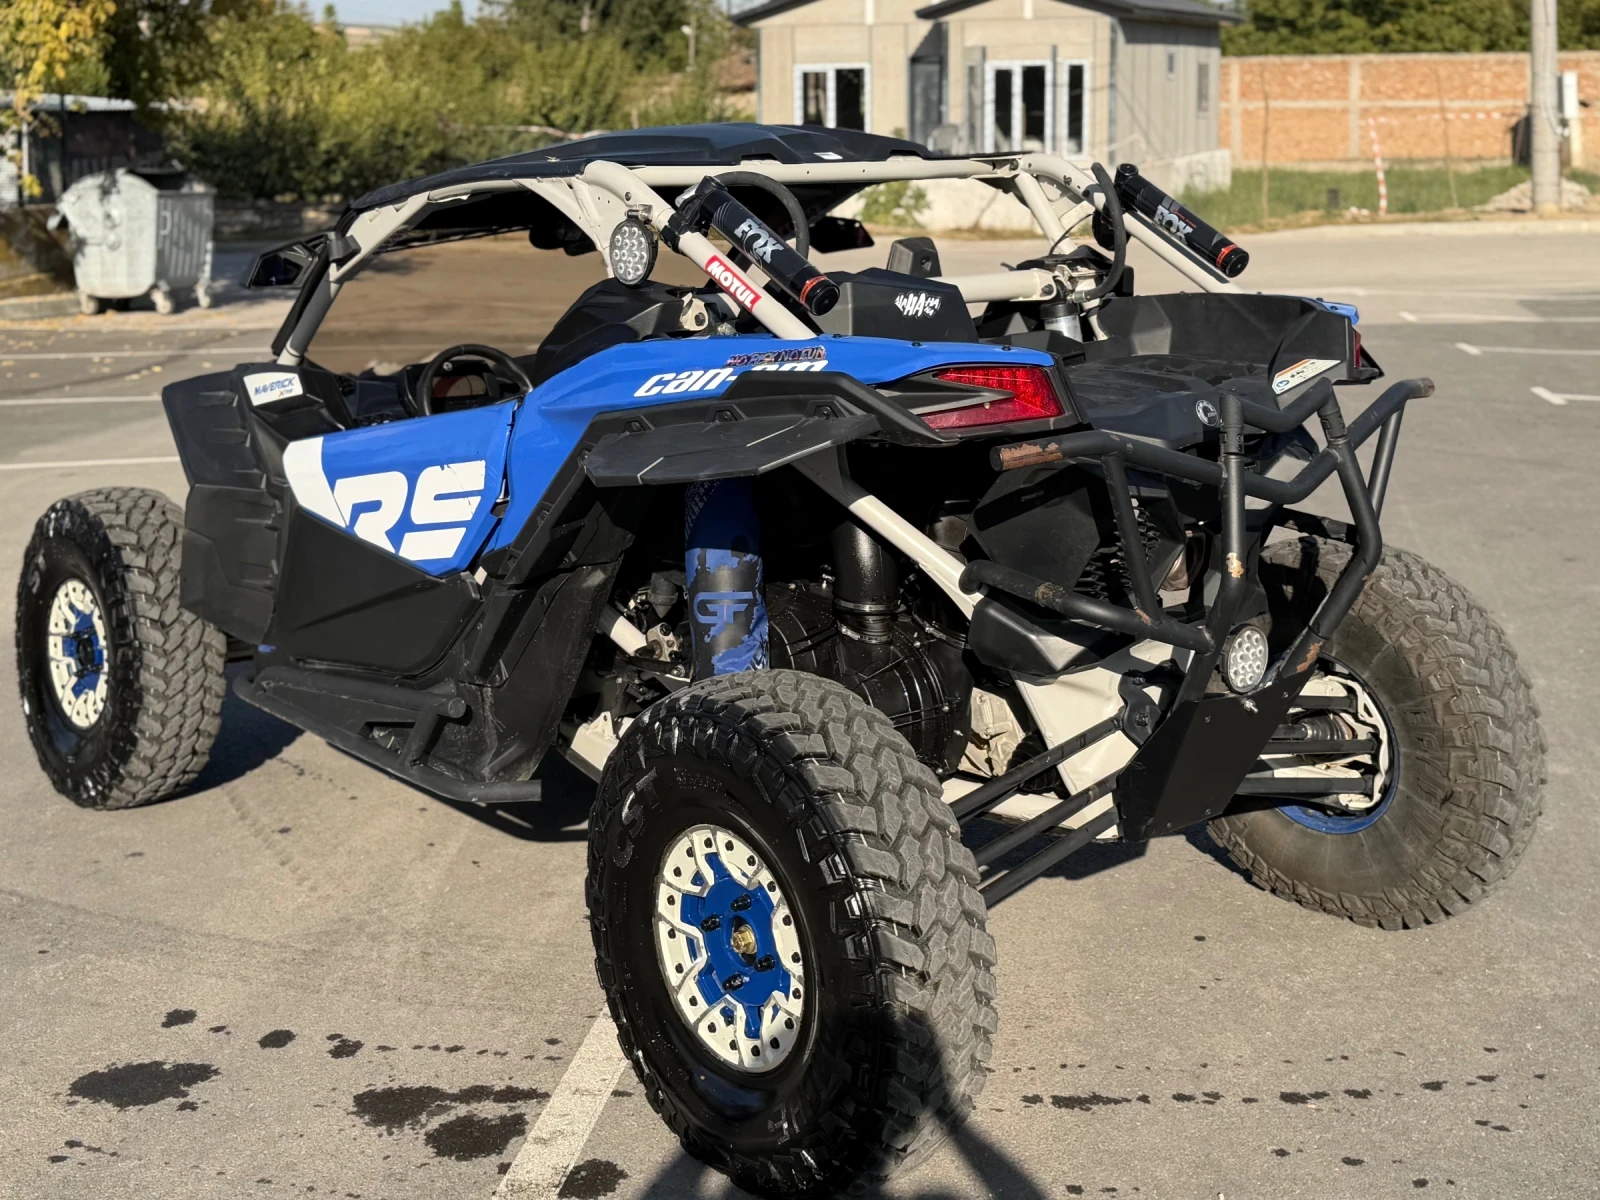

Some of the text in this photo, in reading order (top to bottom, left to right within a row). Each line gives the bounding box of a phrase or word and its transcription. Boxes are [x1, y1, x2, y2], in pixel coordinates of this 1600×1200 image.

[734, 218, 785, 264] FOX
[1154, 204, 1194, 245] FOX
[707, 260, 756, 309] MOTUL
[253, 376, 296, 396] MAVERICK
[334, 460, 485, 561] RS
[612, 766, 662, 869] CST
